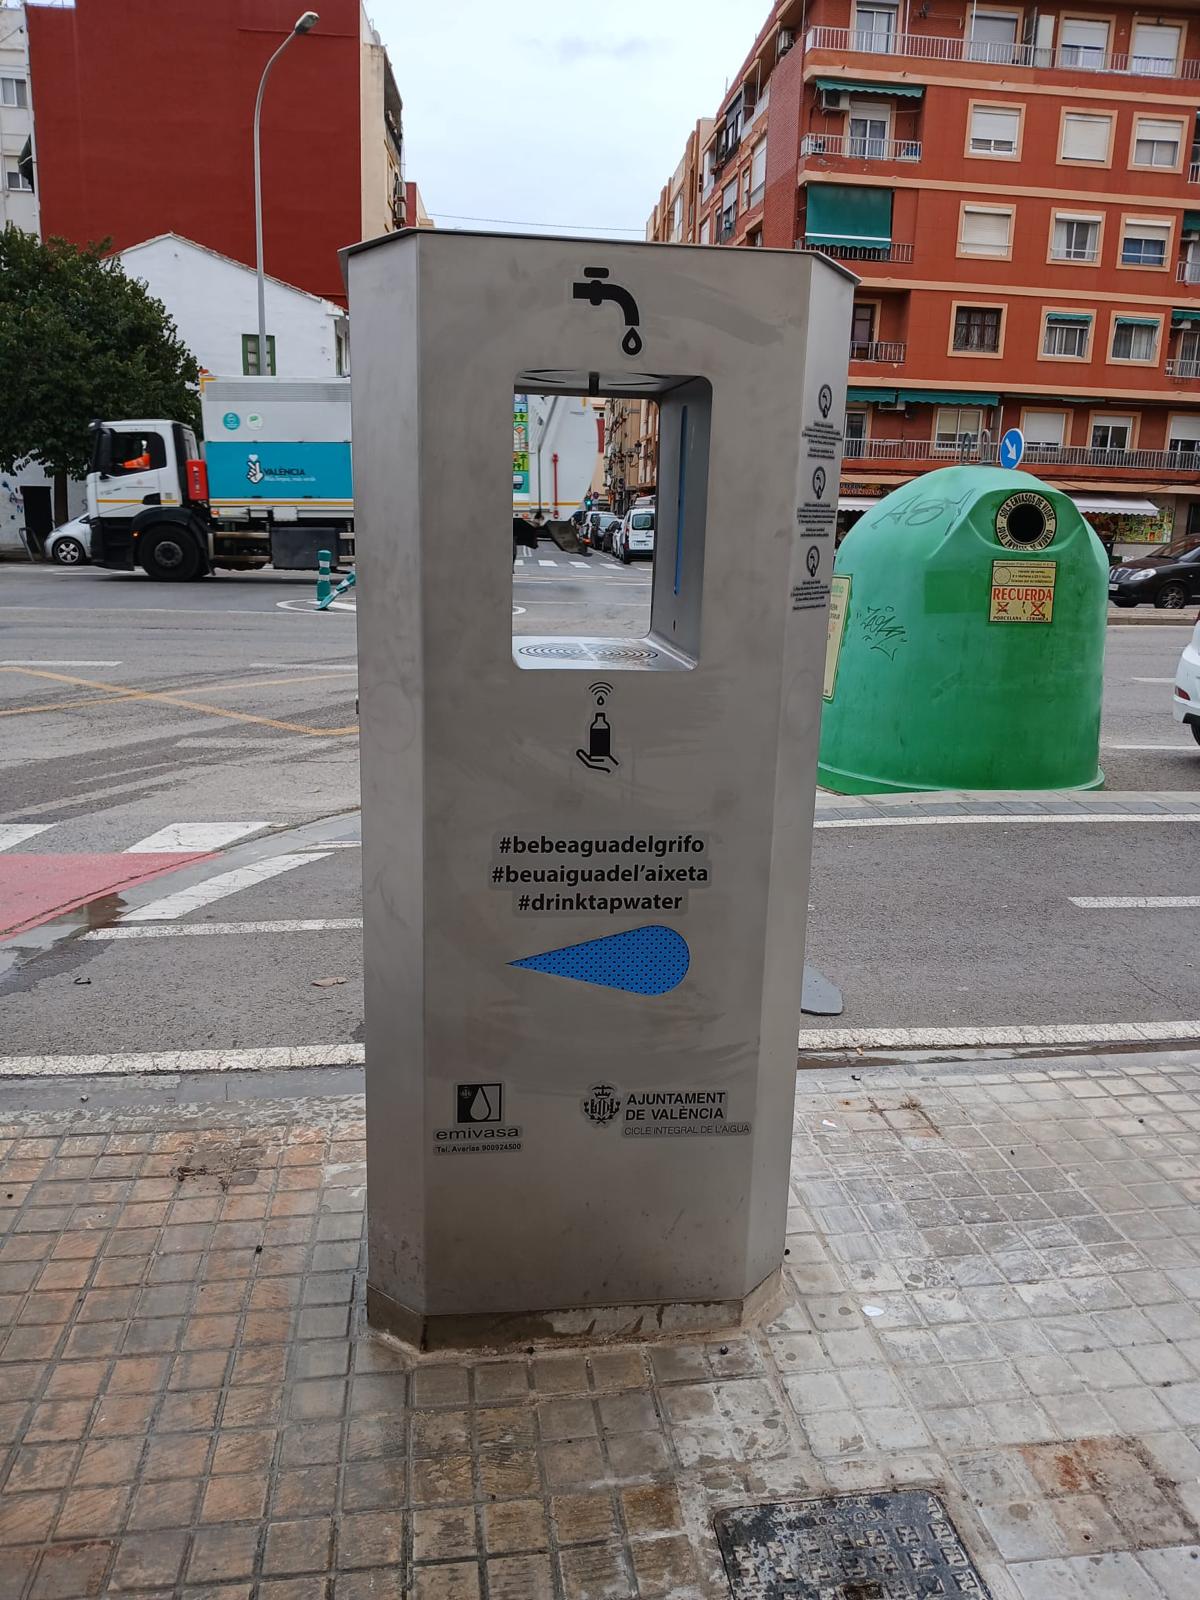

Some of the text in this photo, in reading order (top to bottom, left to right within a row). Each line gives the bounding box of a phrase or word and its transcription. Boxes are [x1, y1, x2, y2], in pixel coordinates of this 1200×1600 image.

[999, 494, 1055, 522] SOLS ENVASOS DE VIDRE
[992, 587, 1053, 601] RECUERDA
[499, 835, 704, 857] #bebeaguadelgrifo
[492, 865, 708, 887] #beuaiguadel'aixeta
[518, 894, 682, 914] #drinktapwater
[626, 1092, 726, 1106] AJUNTAMENT
[625, 1106, 724, 1121] DE VALÈNCIA
[436, 1127, 519, 1140] emivasa
[624, 1124, 750, 1136] CICLE INTEGRAL DE L'AIGUA
[482, 1143, 522, 1151] 900924500
